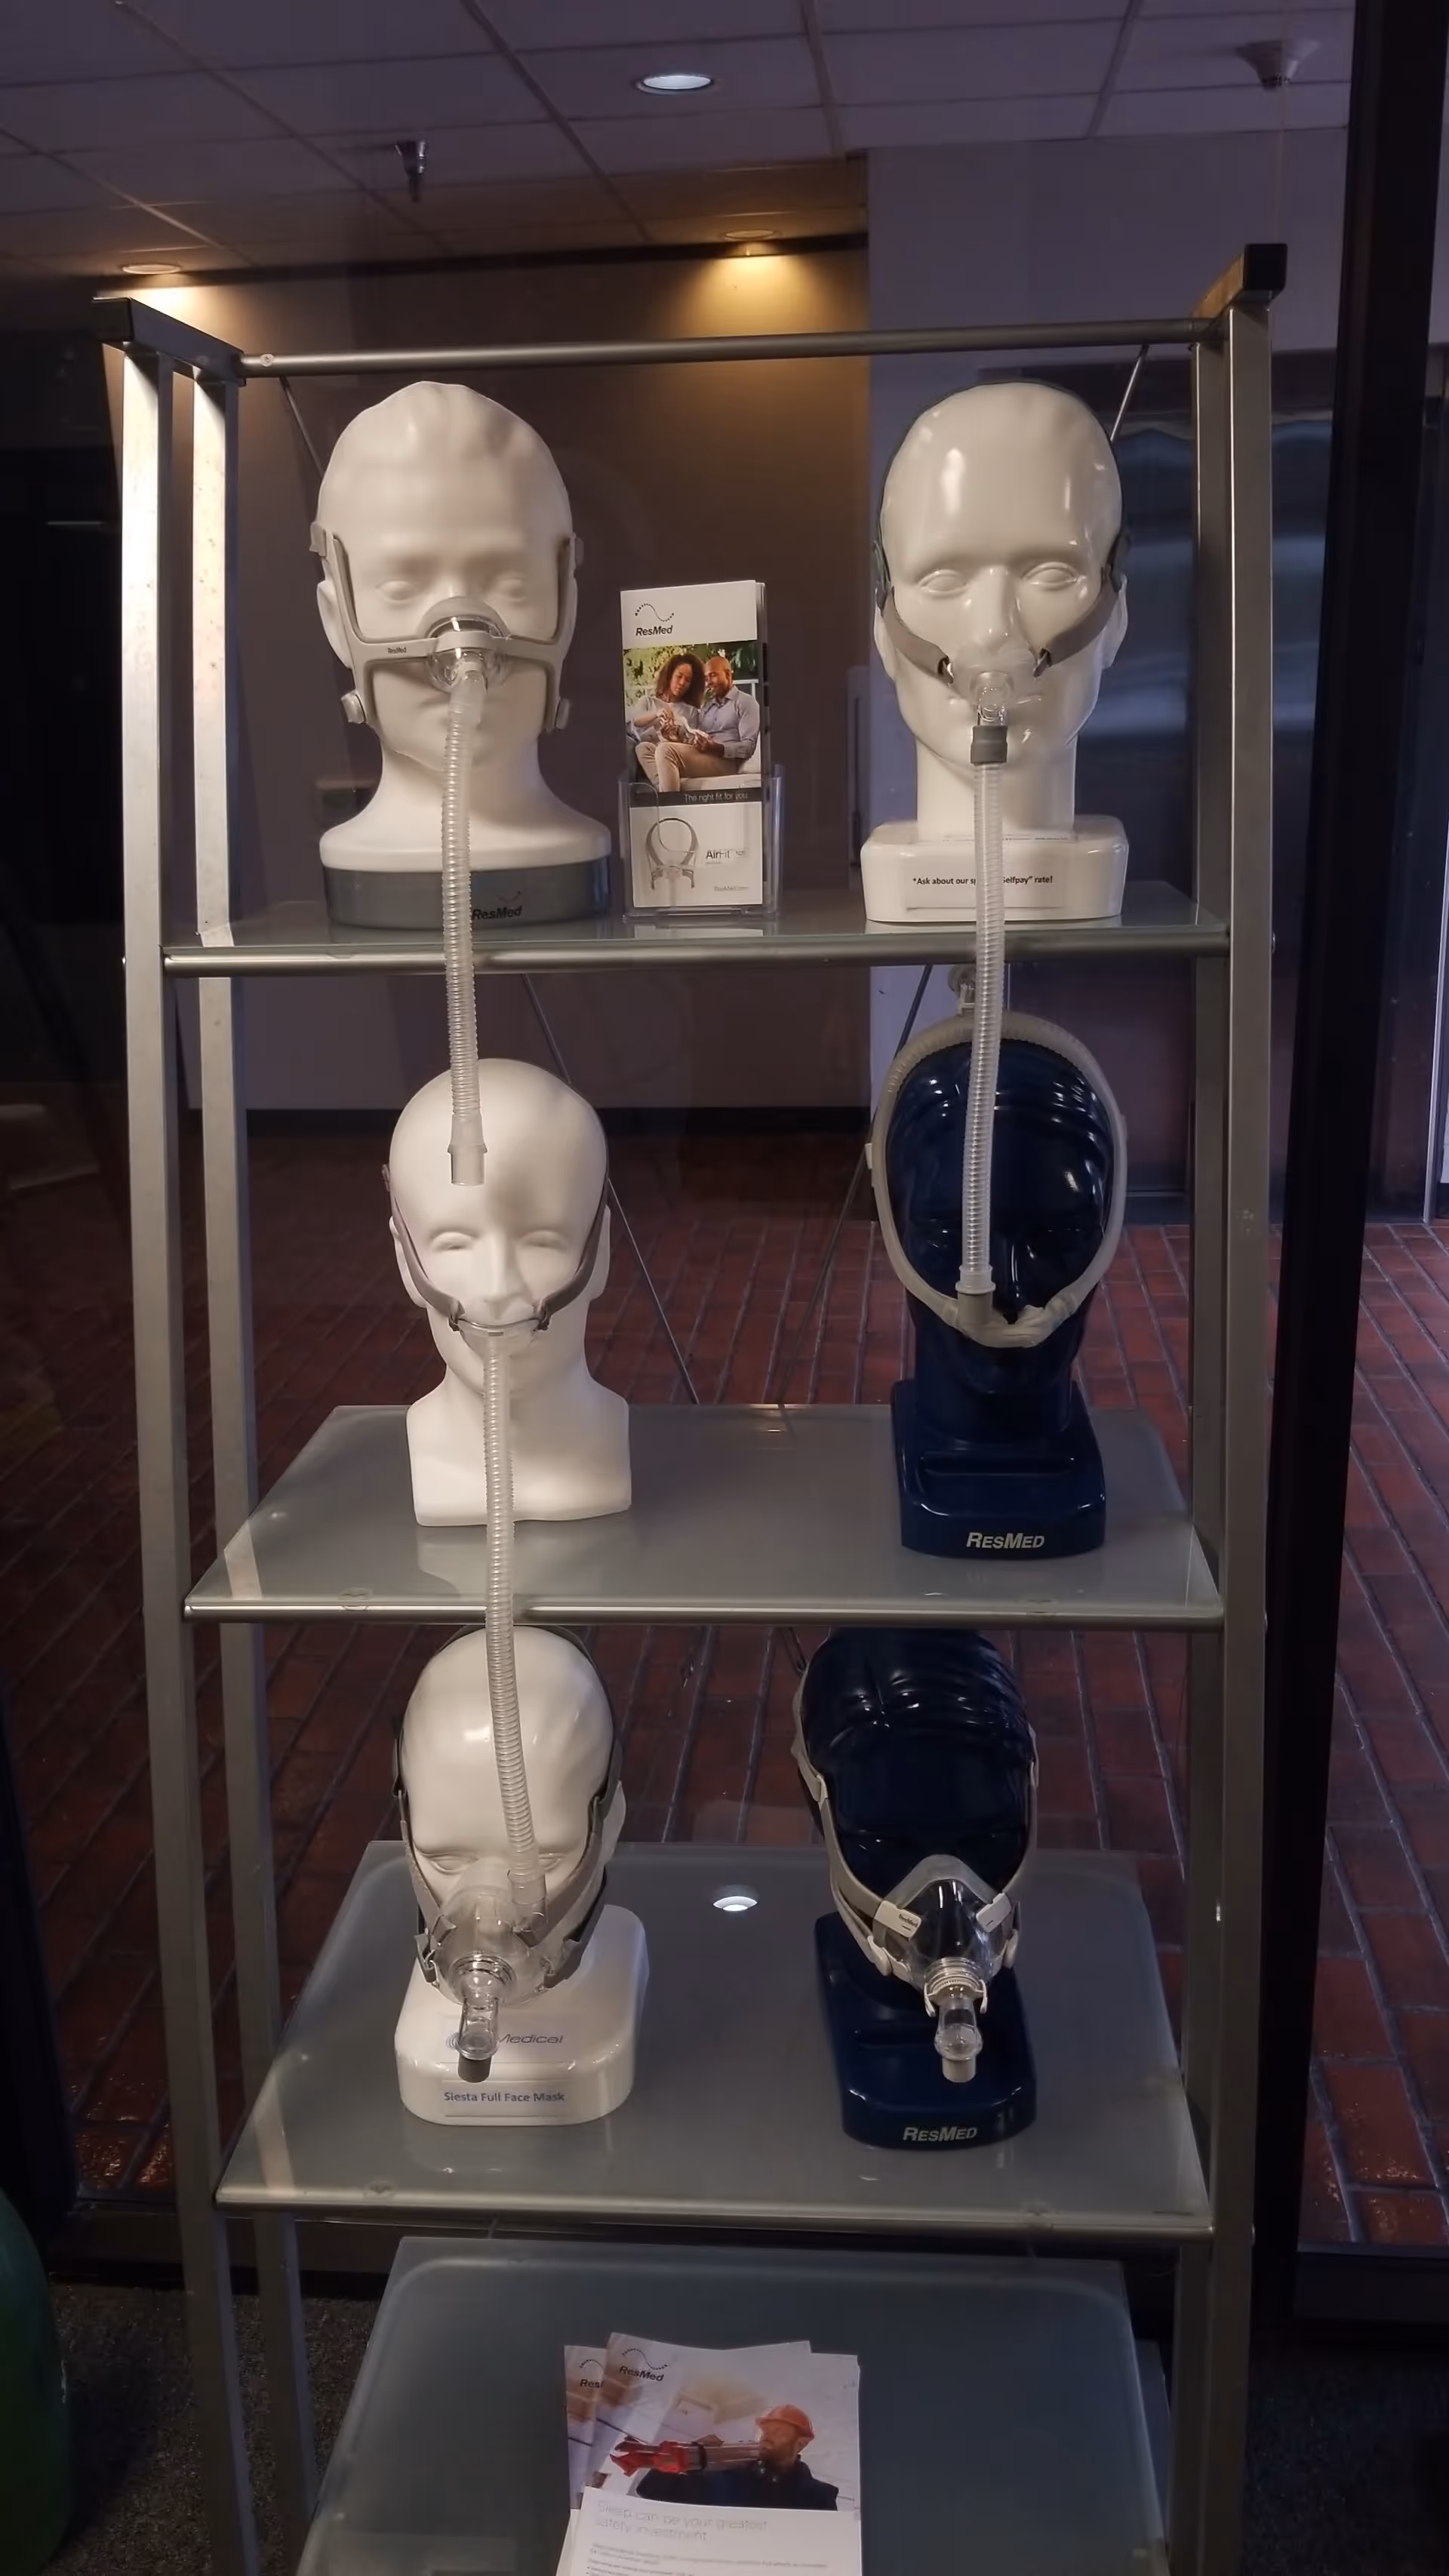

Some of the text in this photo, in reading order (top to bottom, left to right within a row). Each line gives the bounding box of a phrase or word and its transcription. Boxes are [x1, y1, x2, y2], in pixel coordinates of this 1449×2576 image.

[635, 625, 673, 636] ResMed
[685, 794, 697, 802] The
[698, 793, 714, 803] right
[724, 791, 734, 800] for
[735, 792, 748, 802] you
[932, 876, 954, 885] about
[1034, 875, 1054, 884] rate!
[471, 906, 523, 920] ResMed
[444, 2091, 565, 2102] Siesta Full Face Mask
[620, 2365, 665, 2382] ResMed
